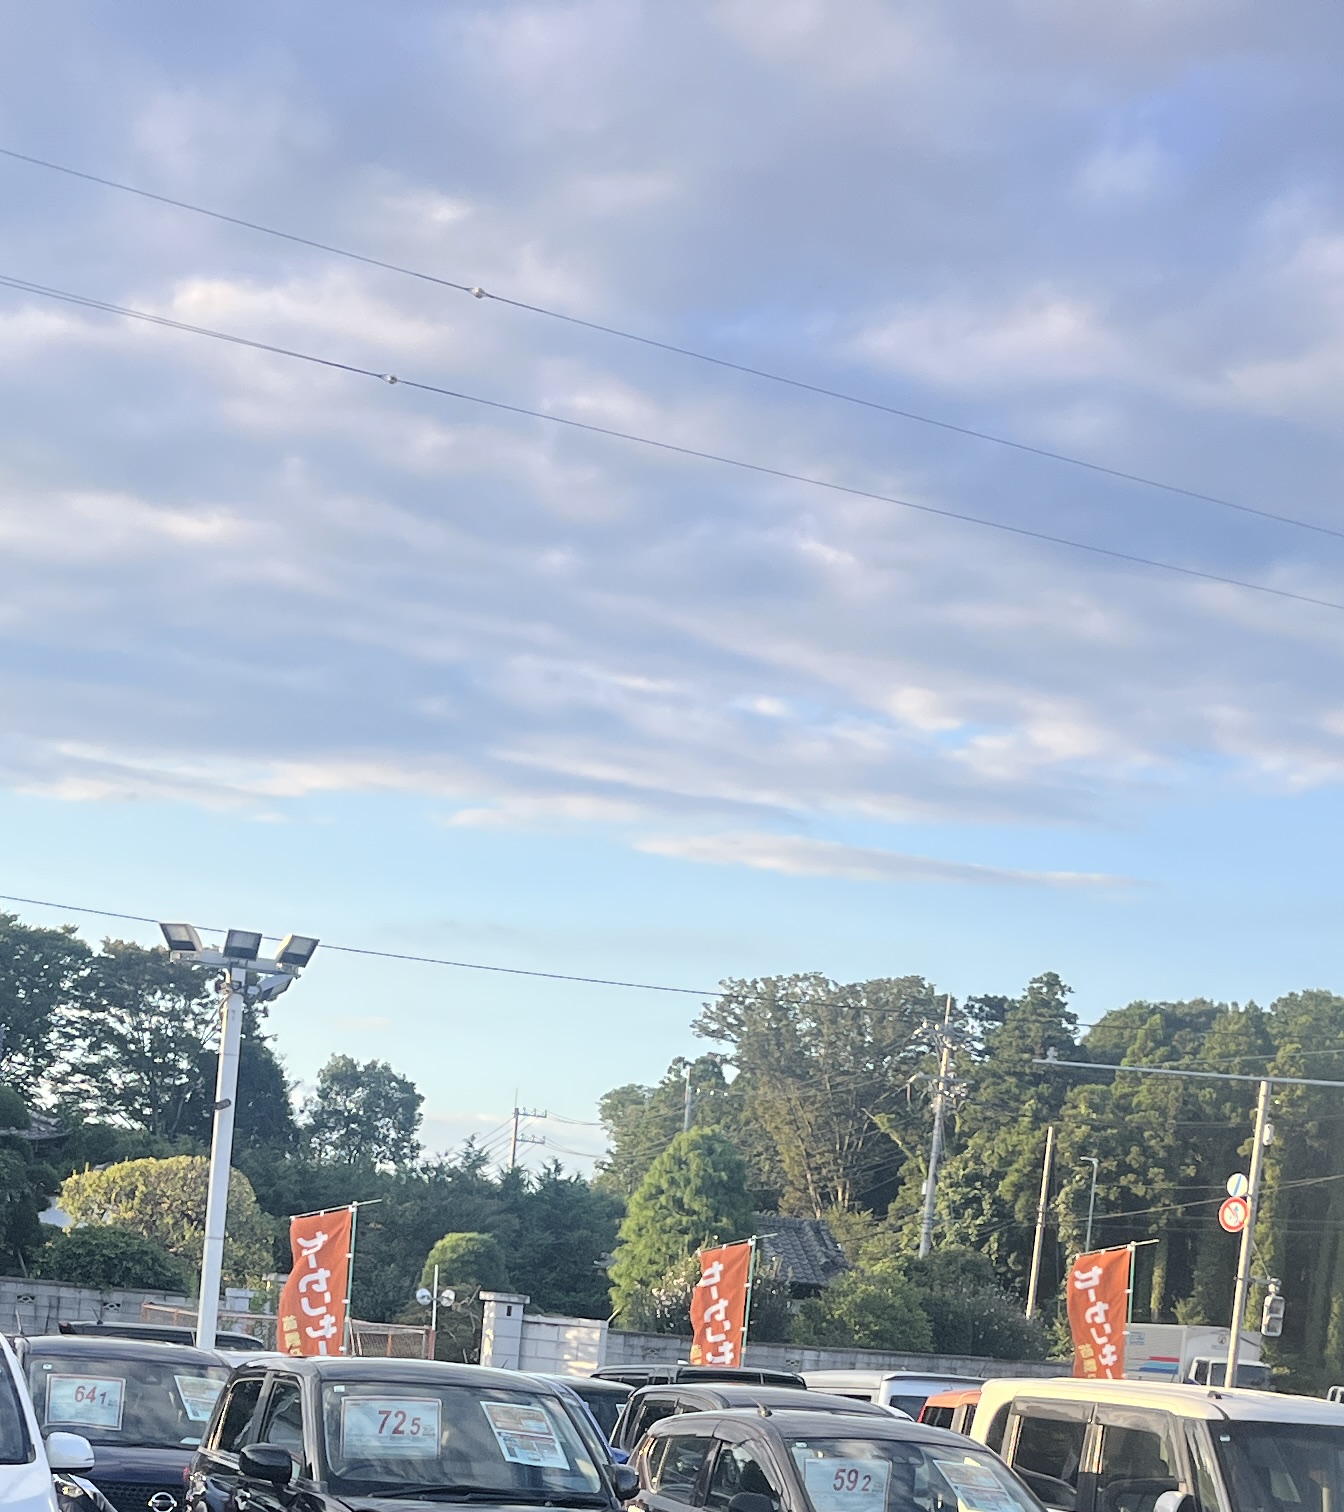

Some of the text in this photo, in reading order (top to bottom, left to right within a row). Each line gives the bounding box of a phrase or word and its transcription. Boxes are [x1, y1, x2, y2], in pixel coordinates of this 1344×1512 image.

[297, 1231, 337, 1355] カーセンサー
[1074, 1265, 1118, 1379] カーセンサー
